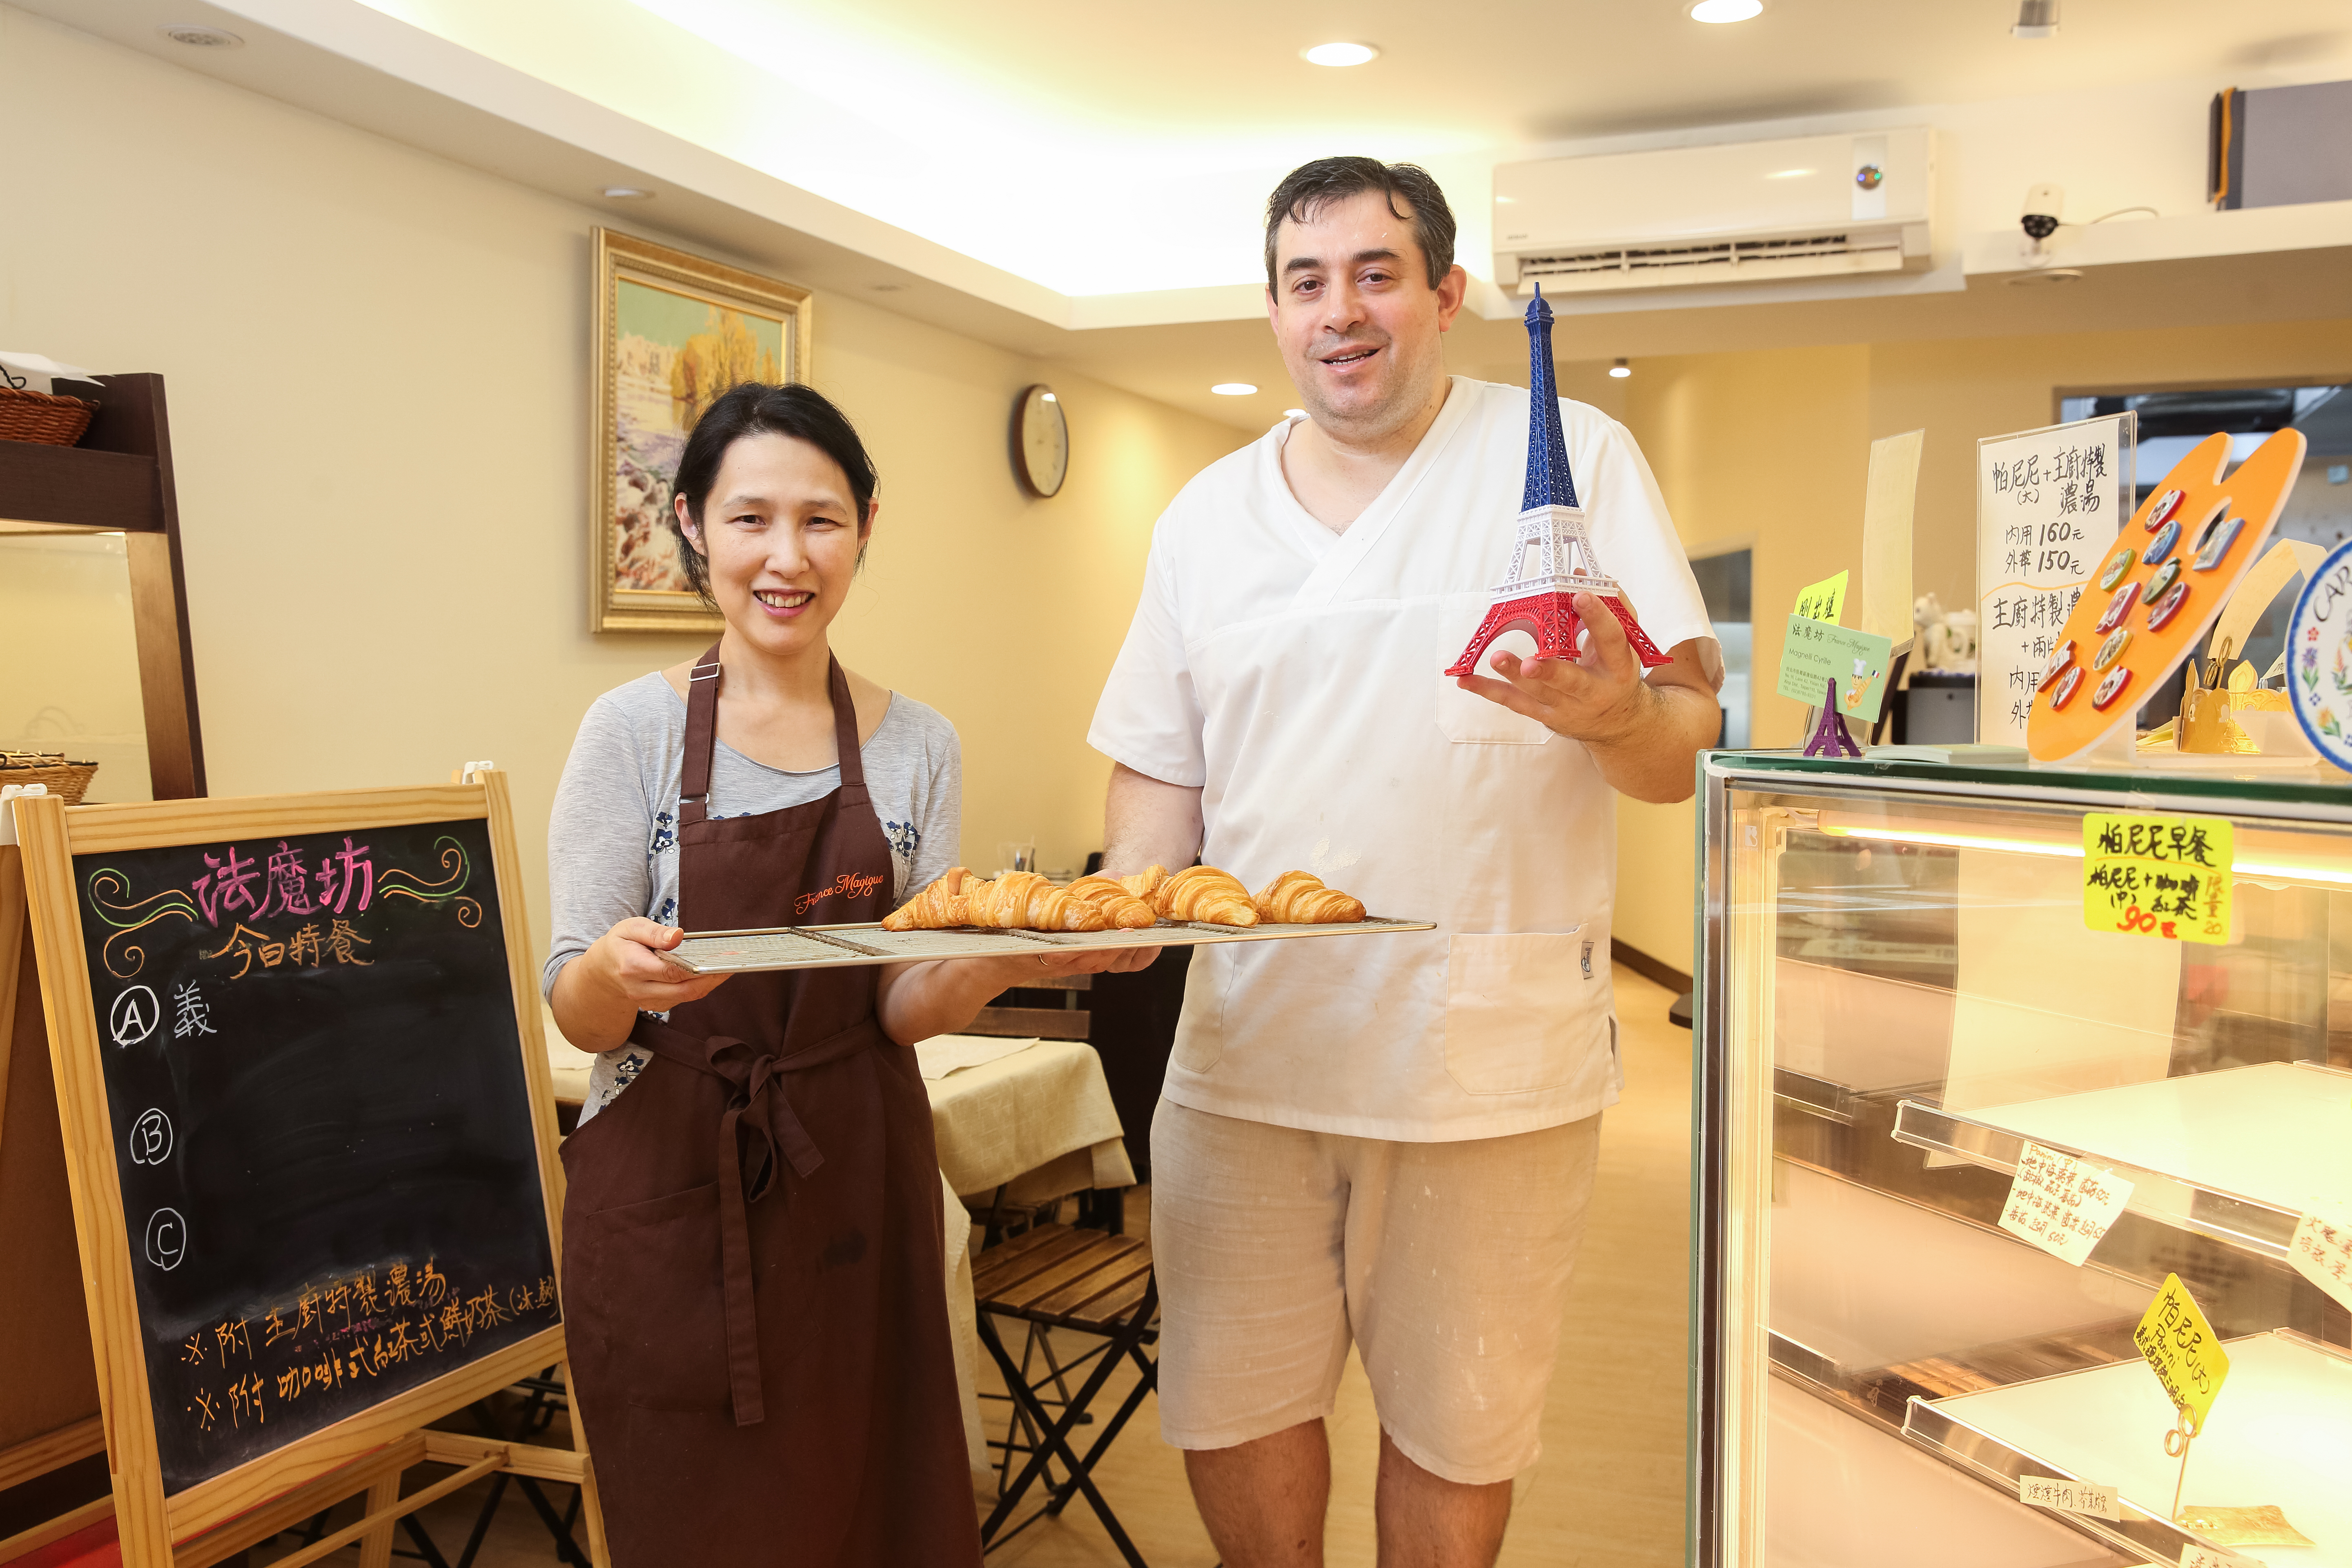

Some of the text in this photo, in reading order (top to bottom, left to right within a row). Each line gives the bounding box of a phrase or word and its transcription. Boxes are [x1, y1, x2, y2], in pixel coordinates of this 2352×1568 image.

[1792, 623, 1824, 642] 法魔坊
[1788, 648, 1831, 666] Magnelli Cyrille
[192, 836, 373, 927] 法魔坊
[835, 873, 884, 899] Magique
[209, 919, 374, 980] 今日特餐
[2029, 1144, 2056, 1161] Panini
[2151, 1323, 2180, 1369] Panini
